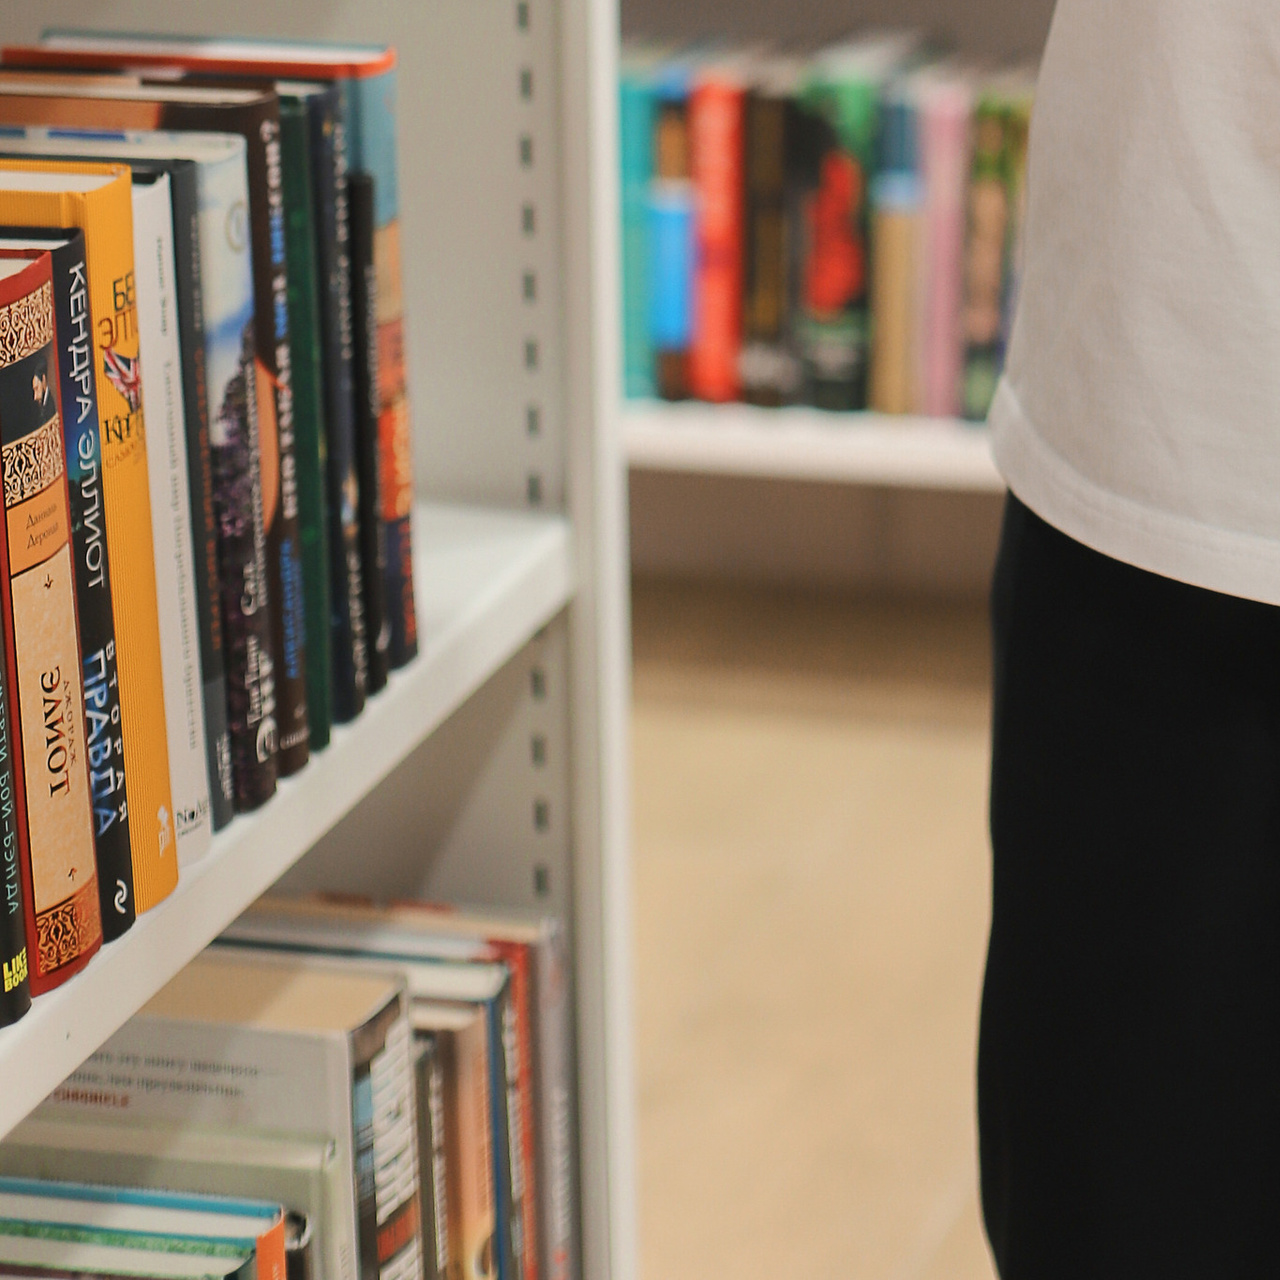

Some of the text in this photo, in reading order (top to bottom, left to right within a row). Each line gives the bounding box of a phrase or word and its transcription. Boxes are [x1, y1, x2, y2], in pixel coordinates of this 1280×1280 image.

[68, 260, 105, 590] КЕНДРА ЭЛЛИОТ
[41, 664, 72, 799] ЭЛИОТ
[84, 646, 118, 837] ПРАВДА
[104, 640, 127, 824] ВТОРАЯ
